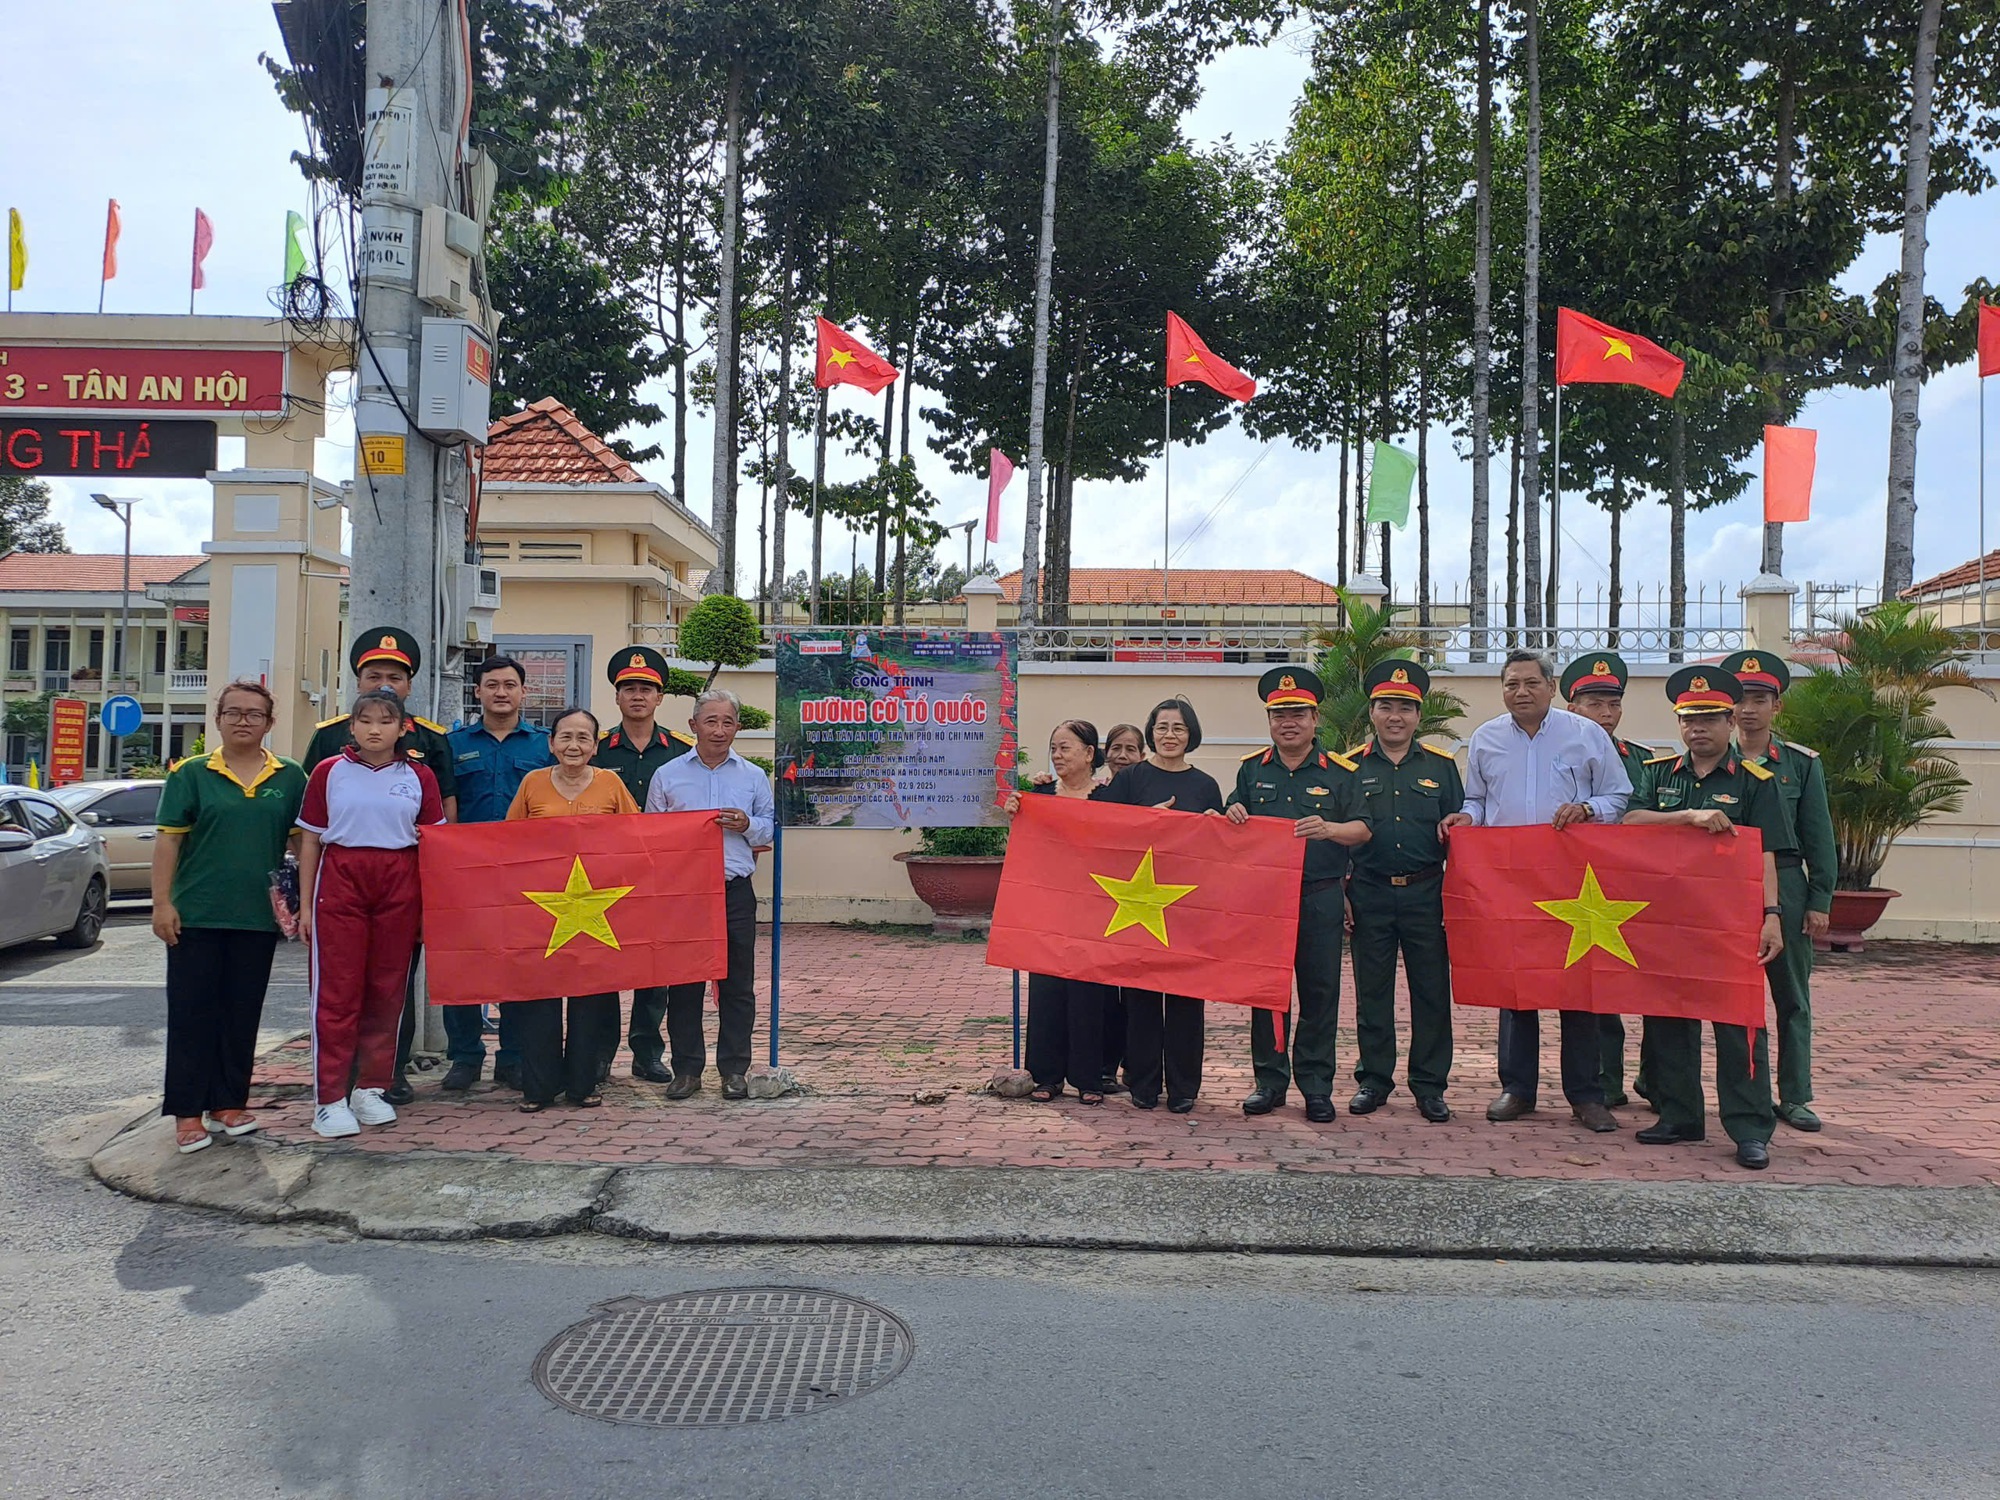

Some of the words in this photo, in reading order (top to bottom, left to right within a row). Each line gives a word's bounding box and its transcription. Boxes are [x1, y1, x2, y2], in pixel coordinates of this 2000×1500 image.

[4, 374, 26, 400] 3
[62, 367, 128, 401] TÂN
[138, 375, 183, 402] AN
[194, 370, 248, 408] HỘI
[370, 450, 385, 464] 10
[801, 696, 867, 724] ĐƯỜNG
[870, 696, 899, 724] CỜ
[903, 693, 928, 723] TỔ
[933, 693, 987, 726] QUỐC
[963, 731, 984, 742] MINH
[937, 794, 954, 803] 2025
[962, 794, 980, 803] 2030
